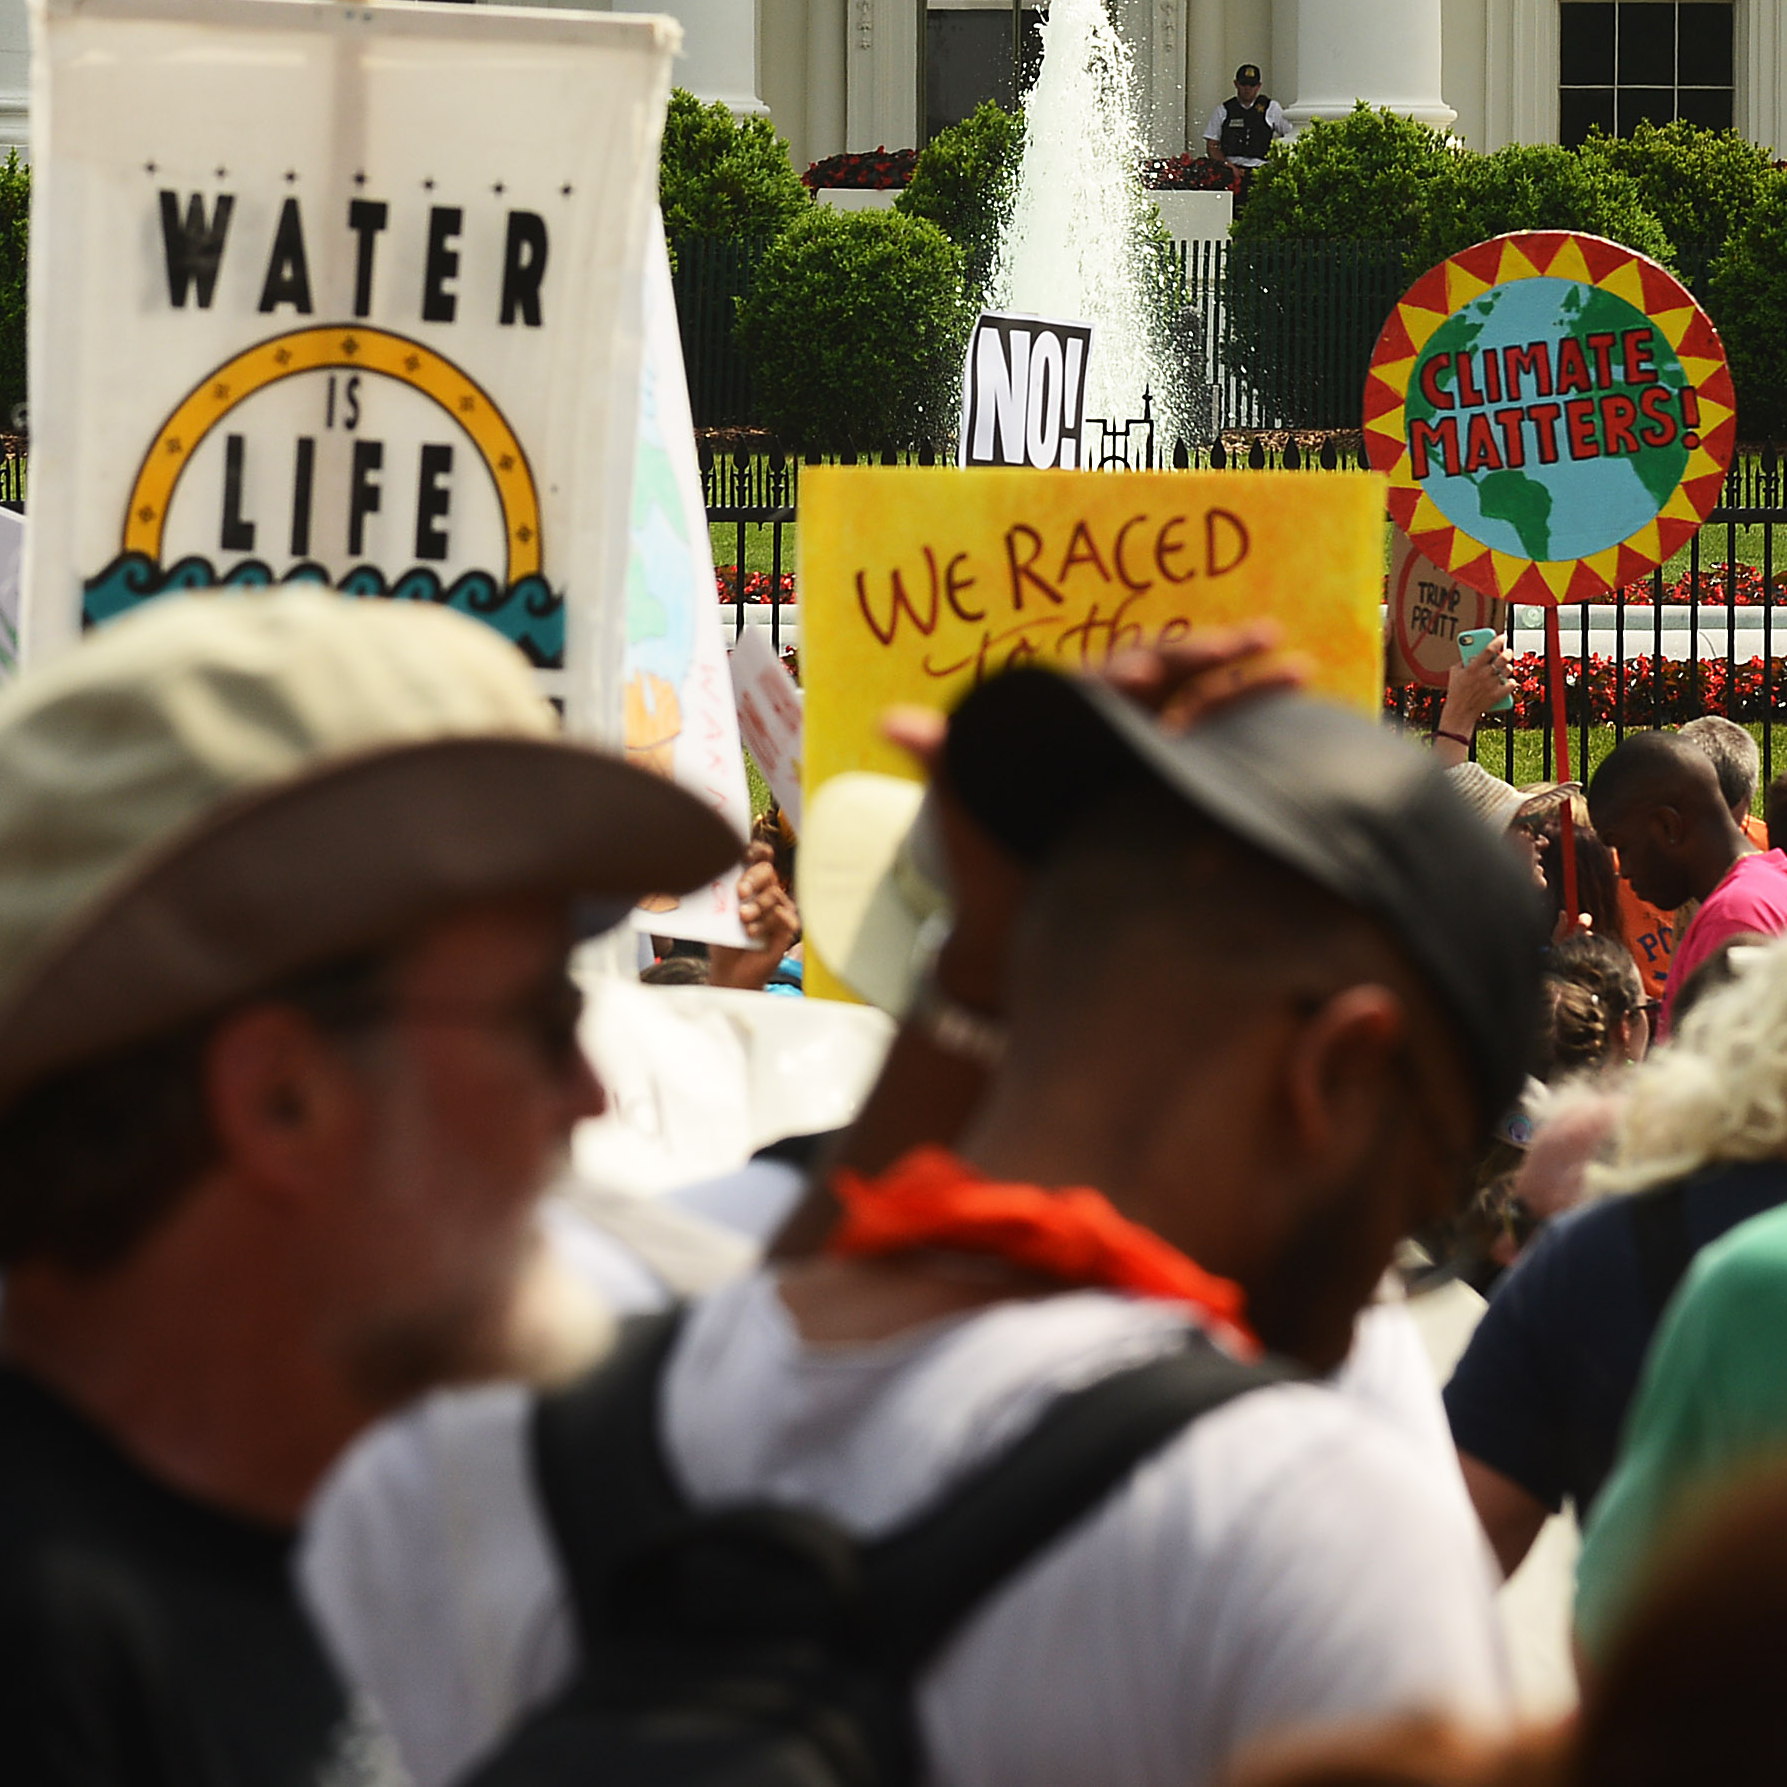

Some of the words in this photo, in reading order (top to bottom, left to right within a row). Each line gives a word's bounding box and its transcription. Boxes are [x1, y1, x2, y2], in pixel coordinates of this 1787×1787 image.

[158, 189, 550, 326] WATER
[325, 374, 361, 431] IS
[972, 328, 1084, 470] NO!
[1419, 327, 1657, 413] CLIMATE
[1408, 386, 1702, 482] MATTERS!
[219, 435, 454, 561] LIFE
[854, 547, 986, 648] WE
[1003, 508, 1252, 610] RACED
